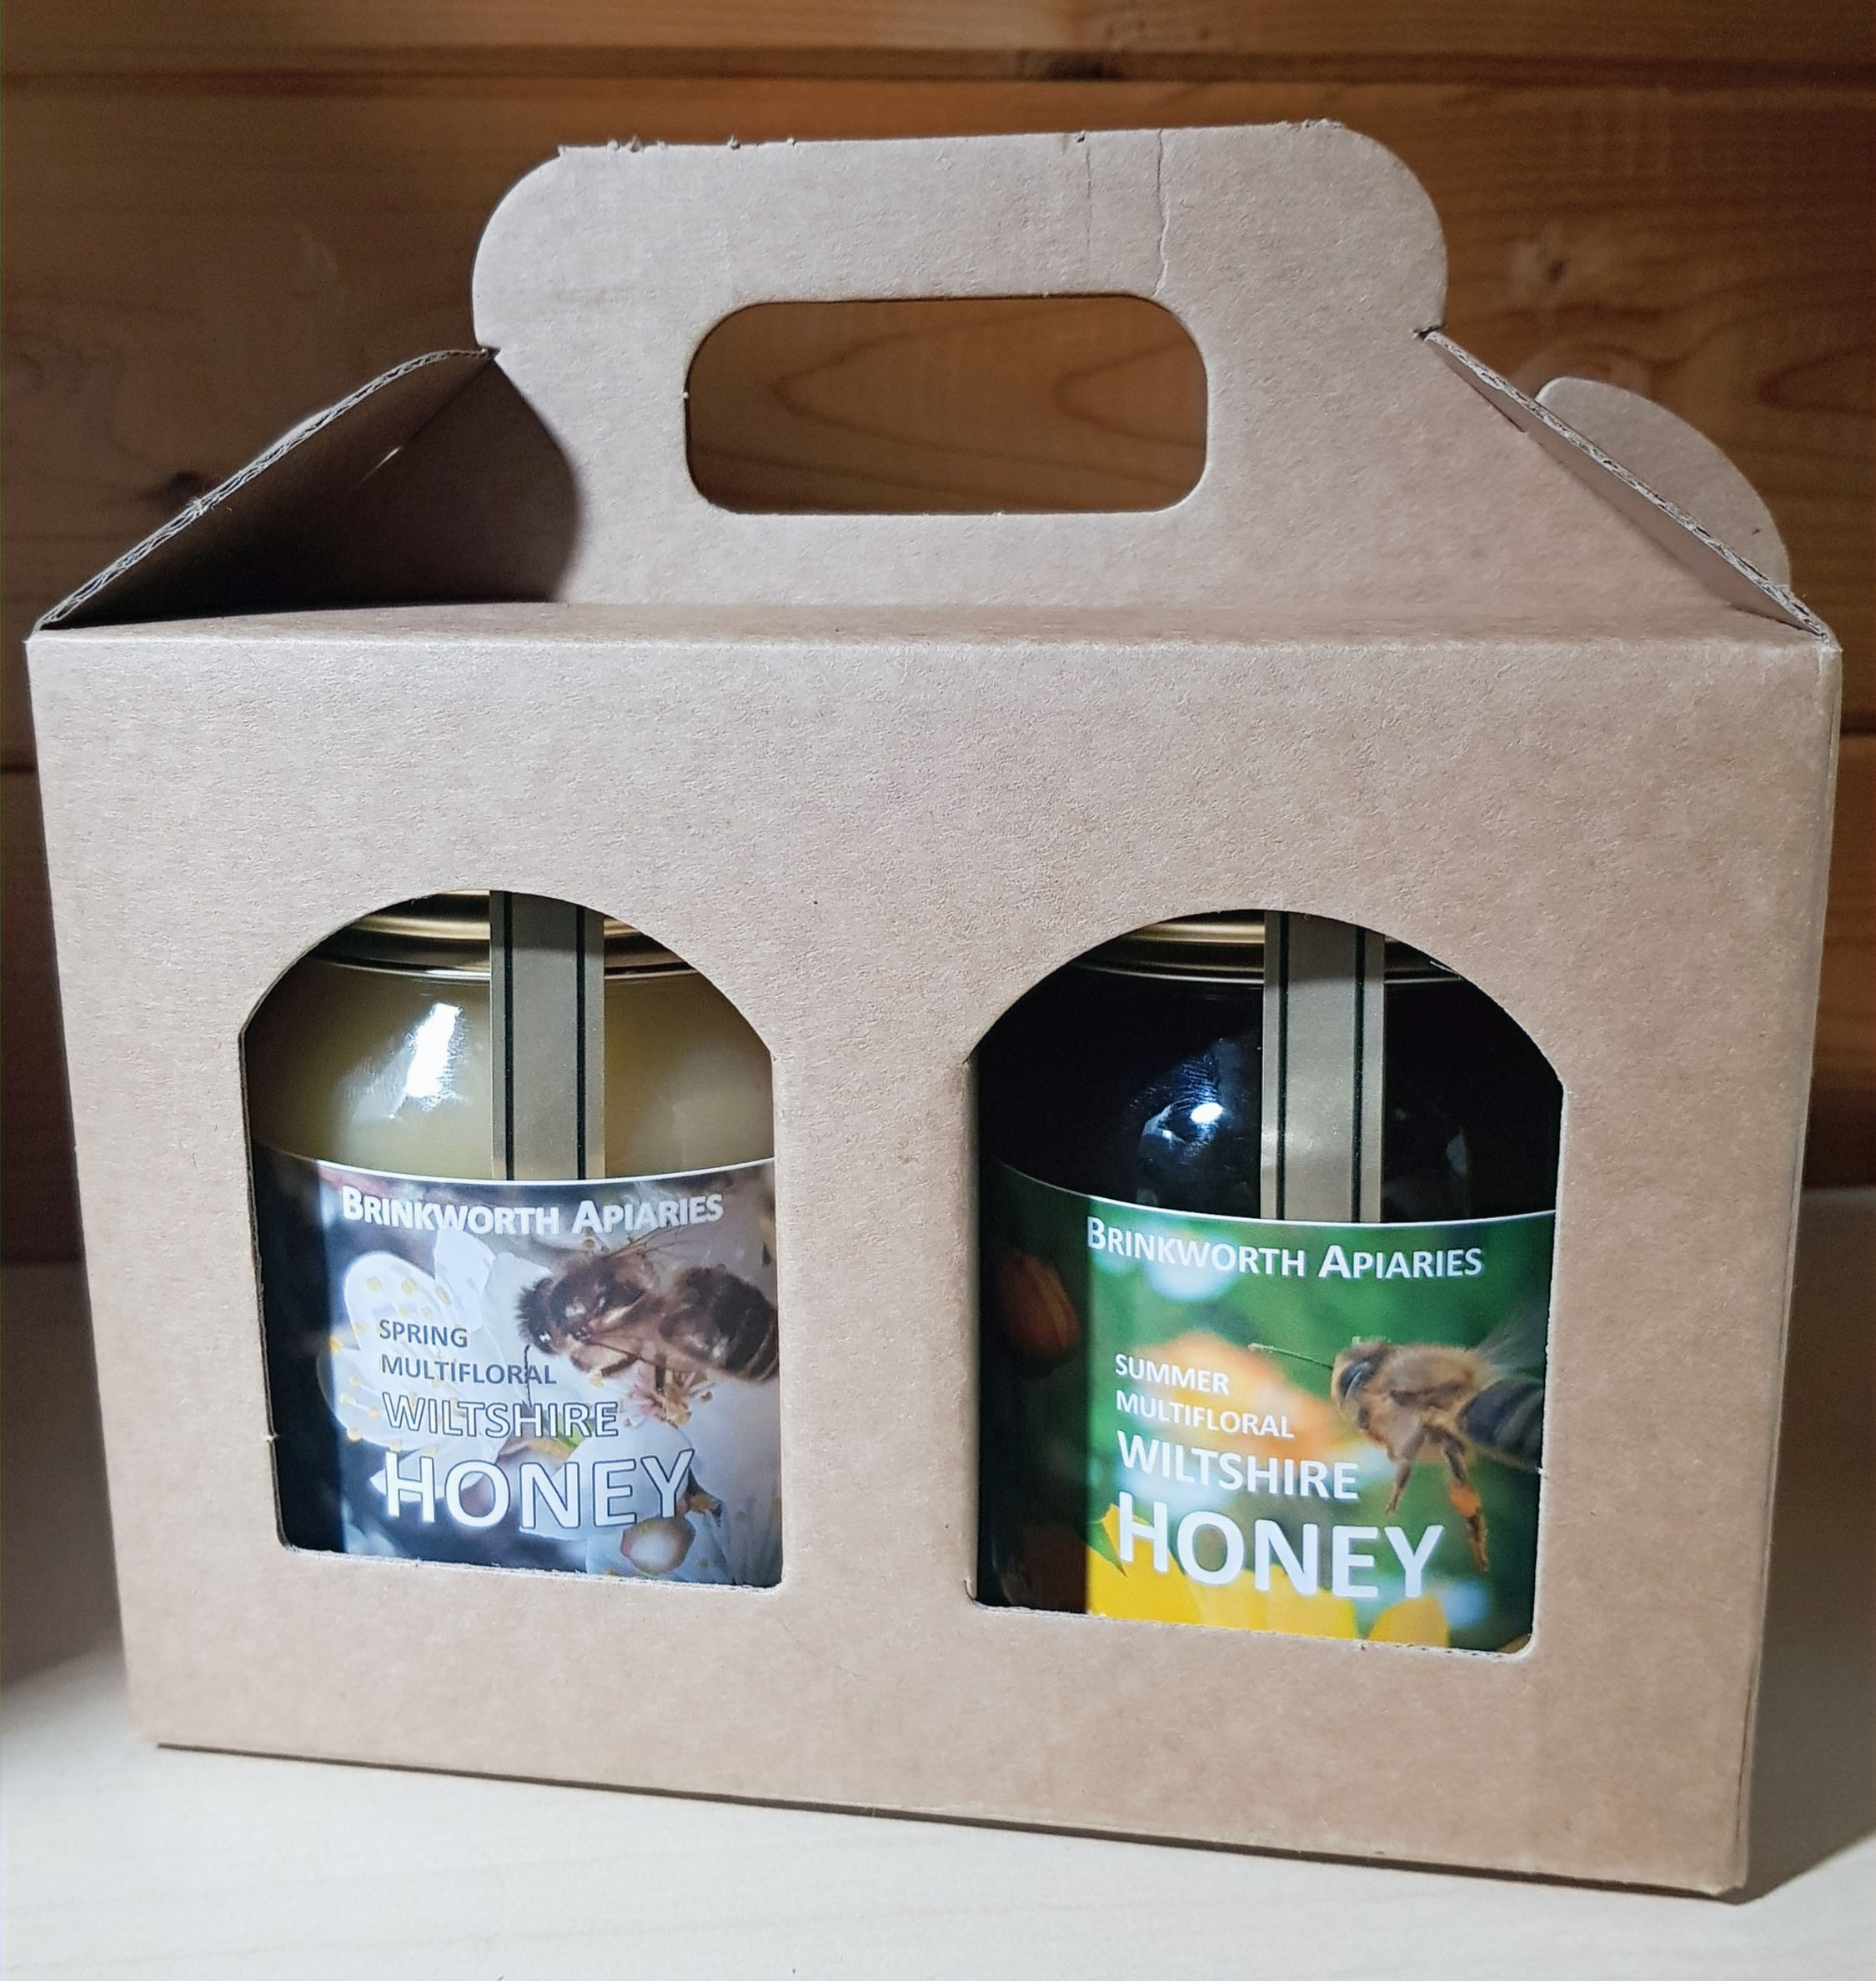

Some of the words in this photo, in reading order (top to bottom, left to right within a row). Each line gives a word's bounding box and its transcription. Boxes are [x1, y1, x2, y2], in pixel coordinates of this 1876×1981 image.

[342, 1185, 559, 1236] BRINKWORTH
[572, 1193, 724, 1235] APIARIES
[1086, 1216, 1306, 1276] BRINKWORTH
[1318, 1244, 1483, 1279] APIARIES
[379, 1319, 469, 1349] SPRING
[380, 1354, 557, 1386] MULTIFLORAL
[1115, 1352, 1230, 1396] SUMMER
[381, 1392, 619, 1439] WILTSHIRE
[1116, 1389, 1295, 1439] MULTIFLORAL
[384, 1447, 695, 1529] HONEY
[1116, 1429, 1359, 1500] WILTSHIRE
[1117, 1491, 1444, 1599] HONEY
